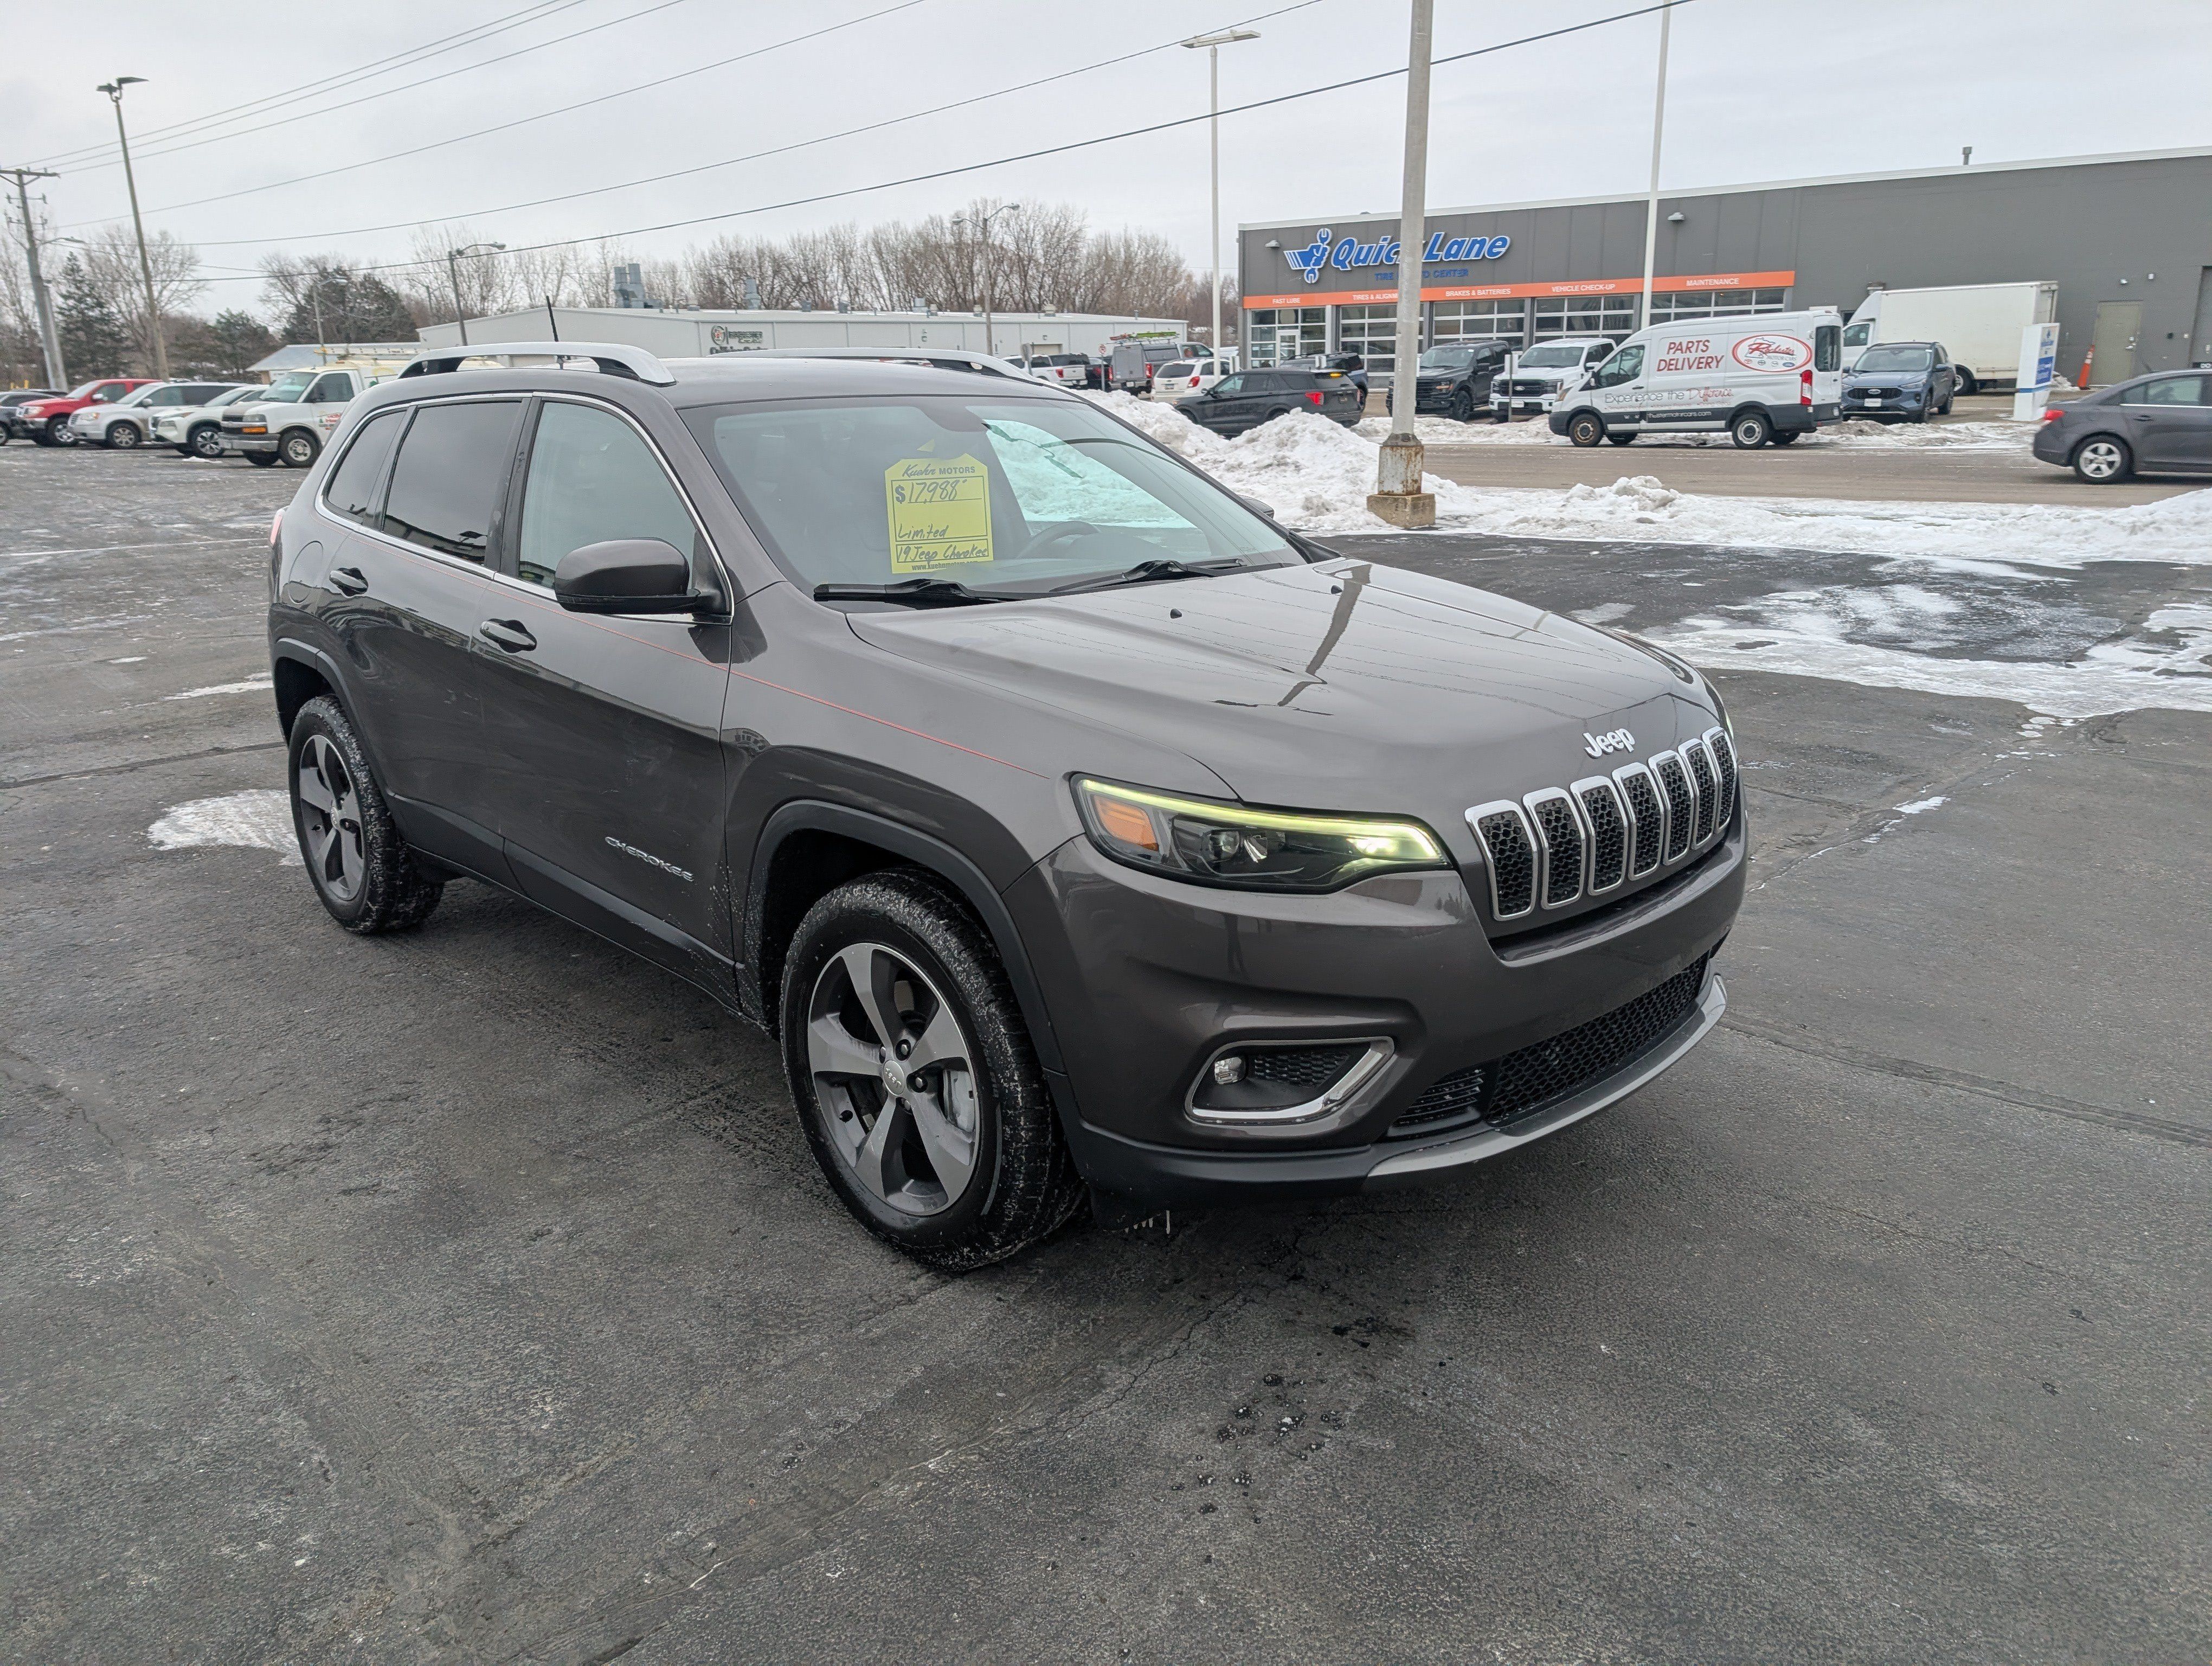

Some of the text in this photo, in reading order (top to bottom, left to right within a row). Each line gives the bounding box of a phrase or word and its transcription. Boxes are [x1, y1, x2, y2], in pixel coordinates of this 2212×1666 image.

[1330, 232, 1510, 271] Quic Lane
[1374, 272, 1393, 281] TIRE
[1433, 268, 1469, 278] CENTER
[1686, 278, 1739, 286] MAINTENANCE
[1666, 339, 1711, 355] PARTS
[1656, 355, 1725, 372] DELIVERY
[1605, 392, 1663, 405] Experience
[1668, 390, 1685, 400] the
[938, 466, 975, 475] MOTORS
[897, 523, 949, 540] Limited
[910, 546, 938, 565] Jeep
[1581, 728, 1636, 759] Jeep
[605, 836, 695, 882] CHEROKEE
